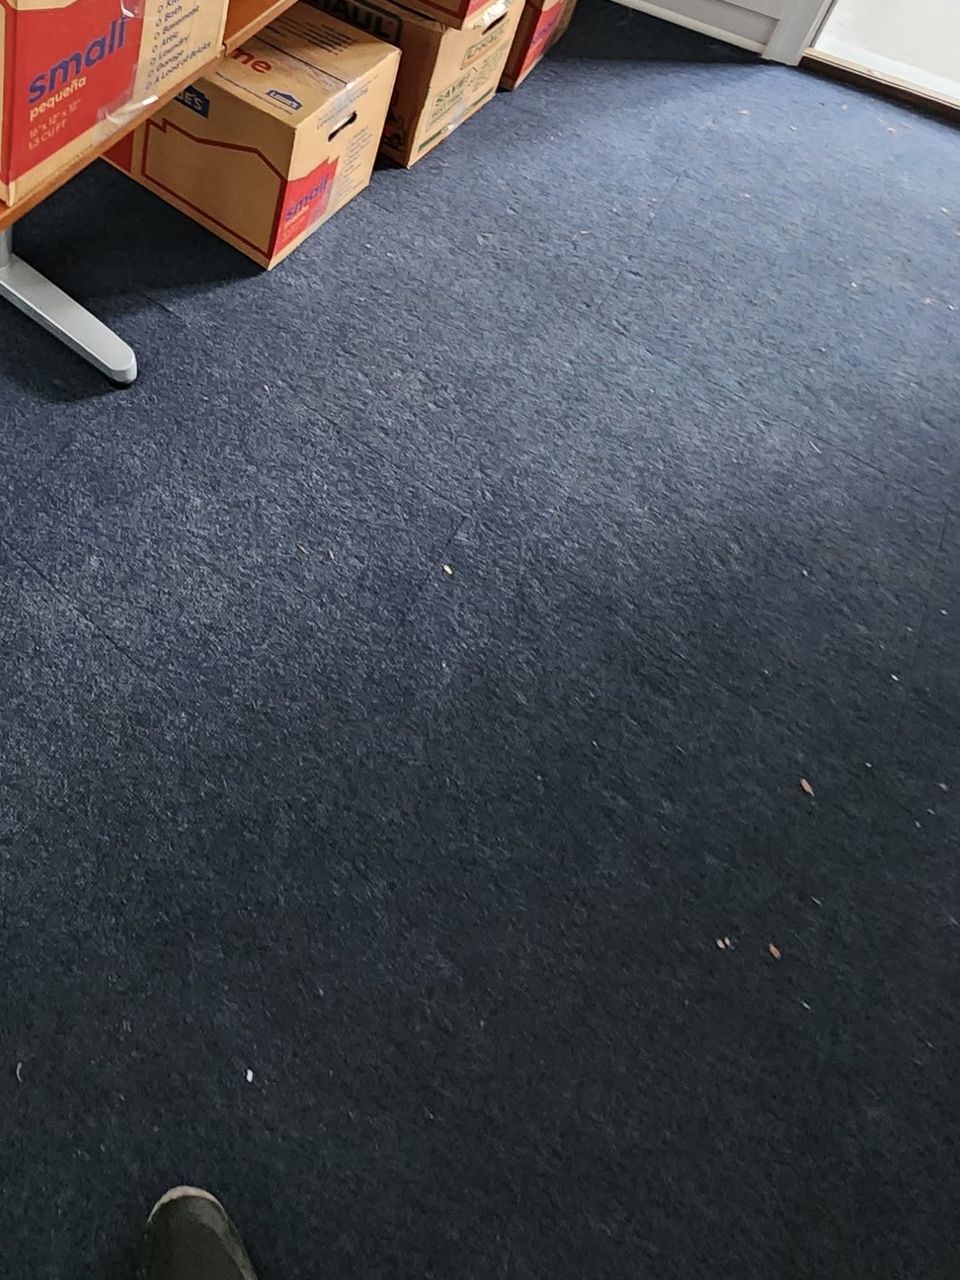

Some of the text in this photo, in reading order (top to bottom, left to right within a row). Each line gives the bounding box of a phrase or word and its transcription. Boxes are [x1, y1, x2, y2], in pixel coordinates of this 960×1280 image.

[162, 5, 200, 35] Basement
[164, 5, 183, 22] Bath
[158, 36, 189, 61] Laundry
[161, 31, 179, 48] Attic
[27, 15, 128, 104] small
[156, 50, 184, 72] Garage
[162, 63, 182, 81] Load
[189, 41, 211, 63] Bricks
[29, 75, 88, 122] pequeña
[287, 176, 329, 219] small
